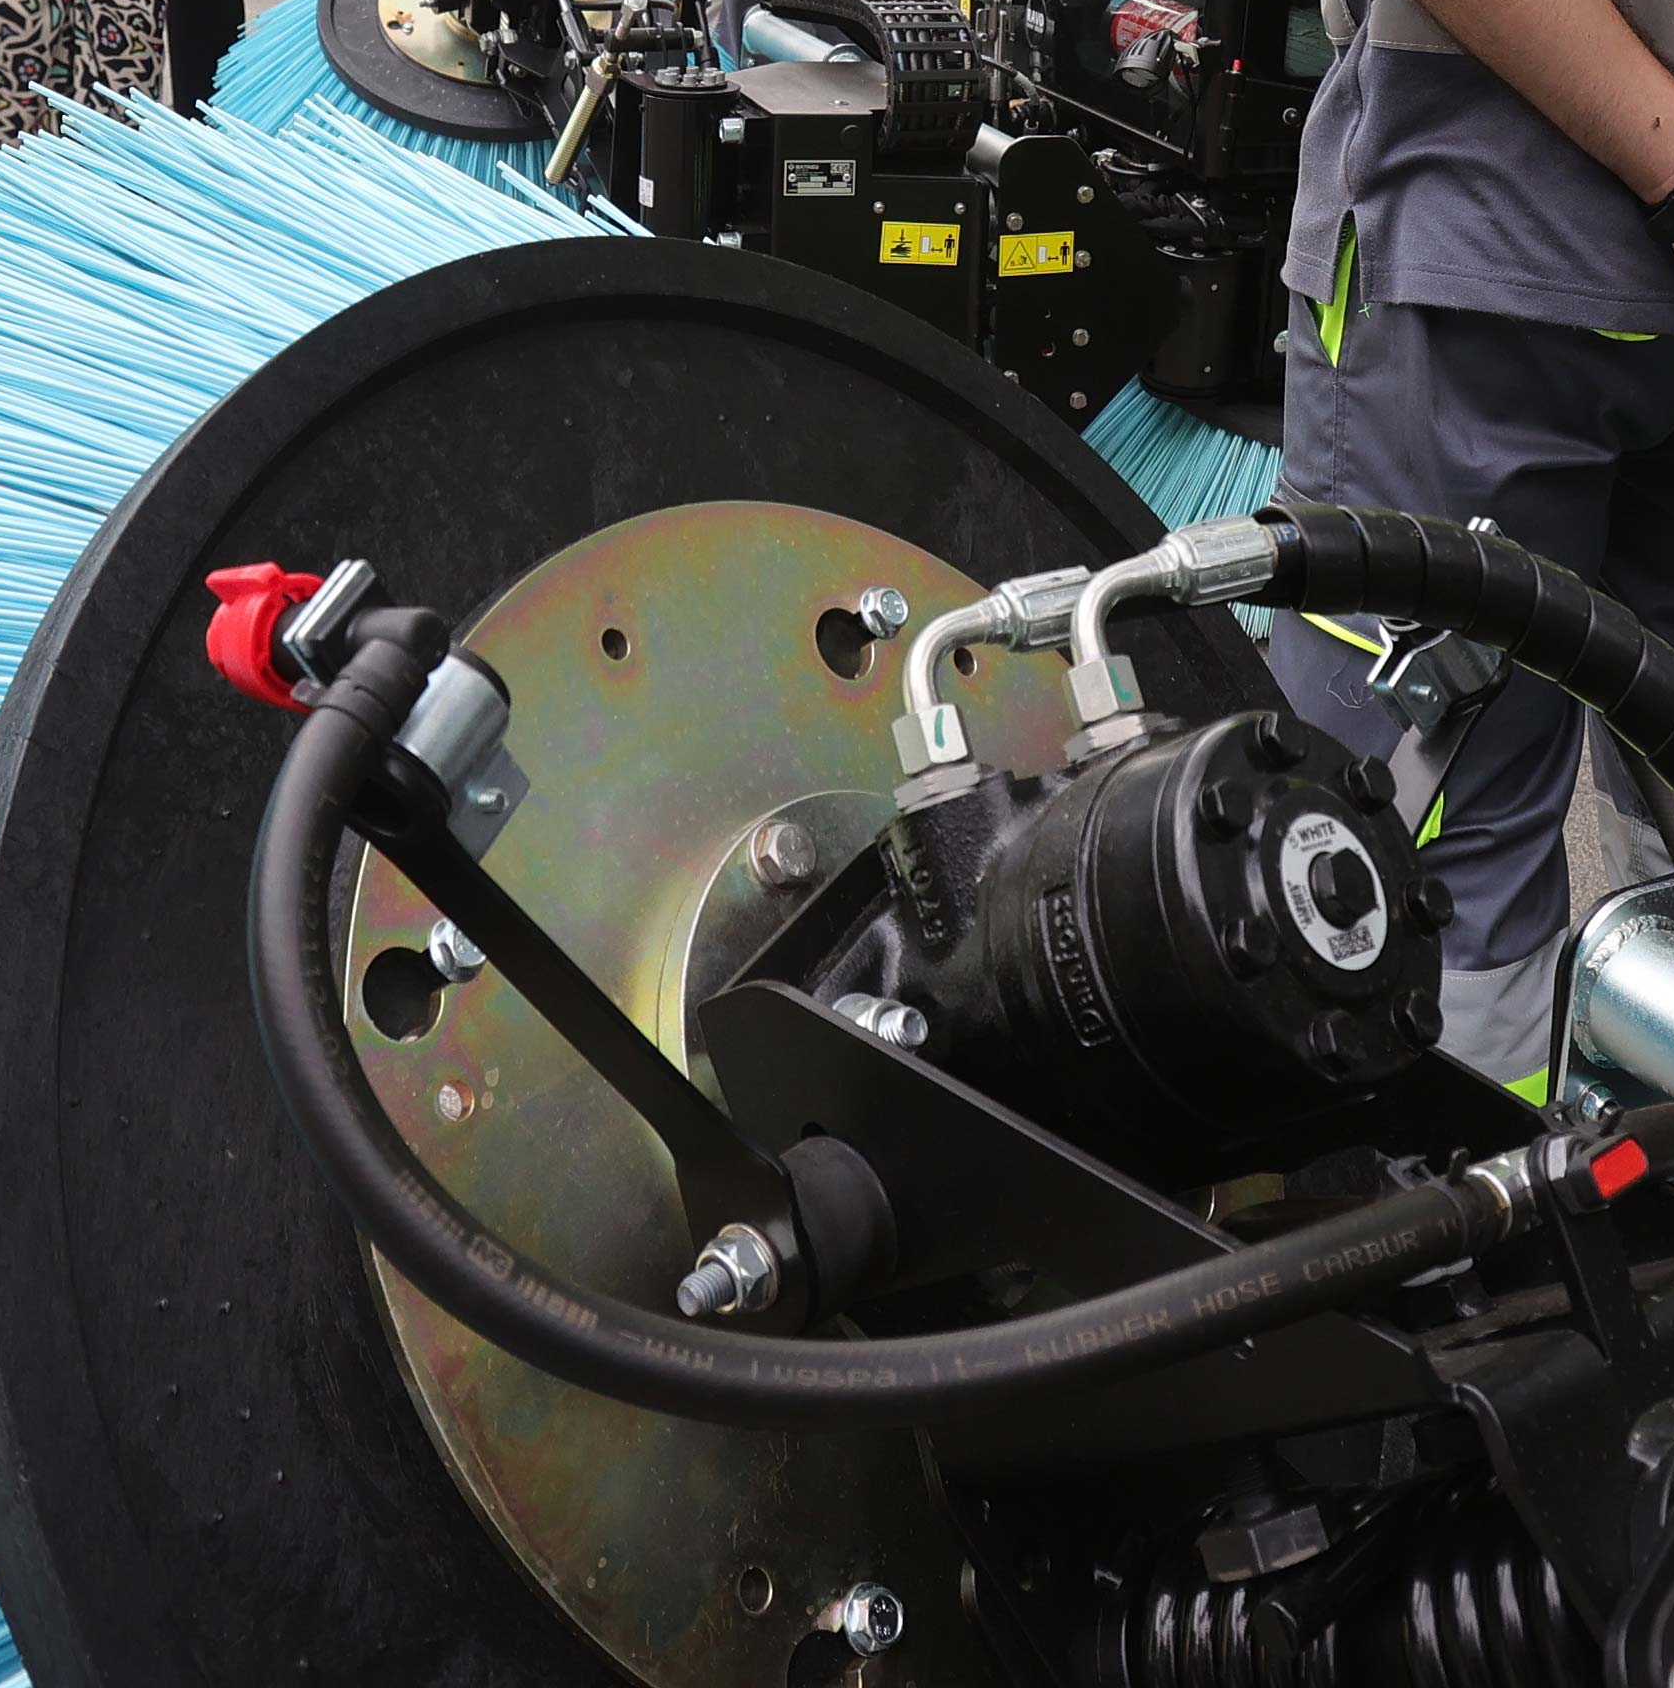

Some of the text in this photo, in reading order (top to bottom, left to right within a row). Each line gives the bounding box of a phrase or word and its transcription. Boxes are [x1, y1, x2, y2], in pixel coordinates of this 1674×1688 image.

[1296, 820, 1337, 845] WHITE
[1193, 1272, 1284, 1318] HOSE
[1302, 1228, 1421, 1284] CARBUR
